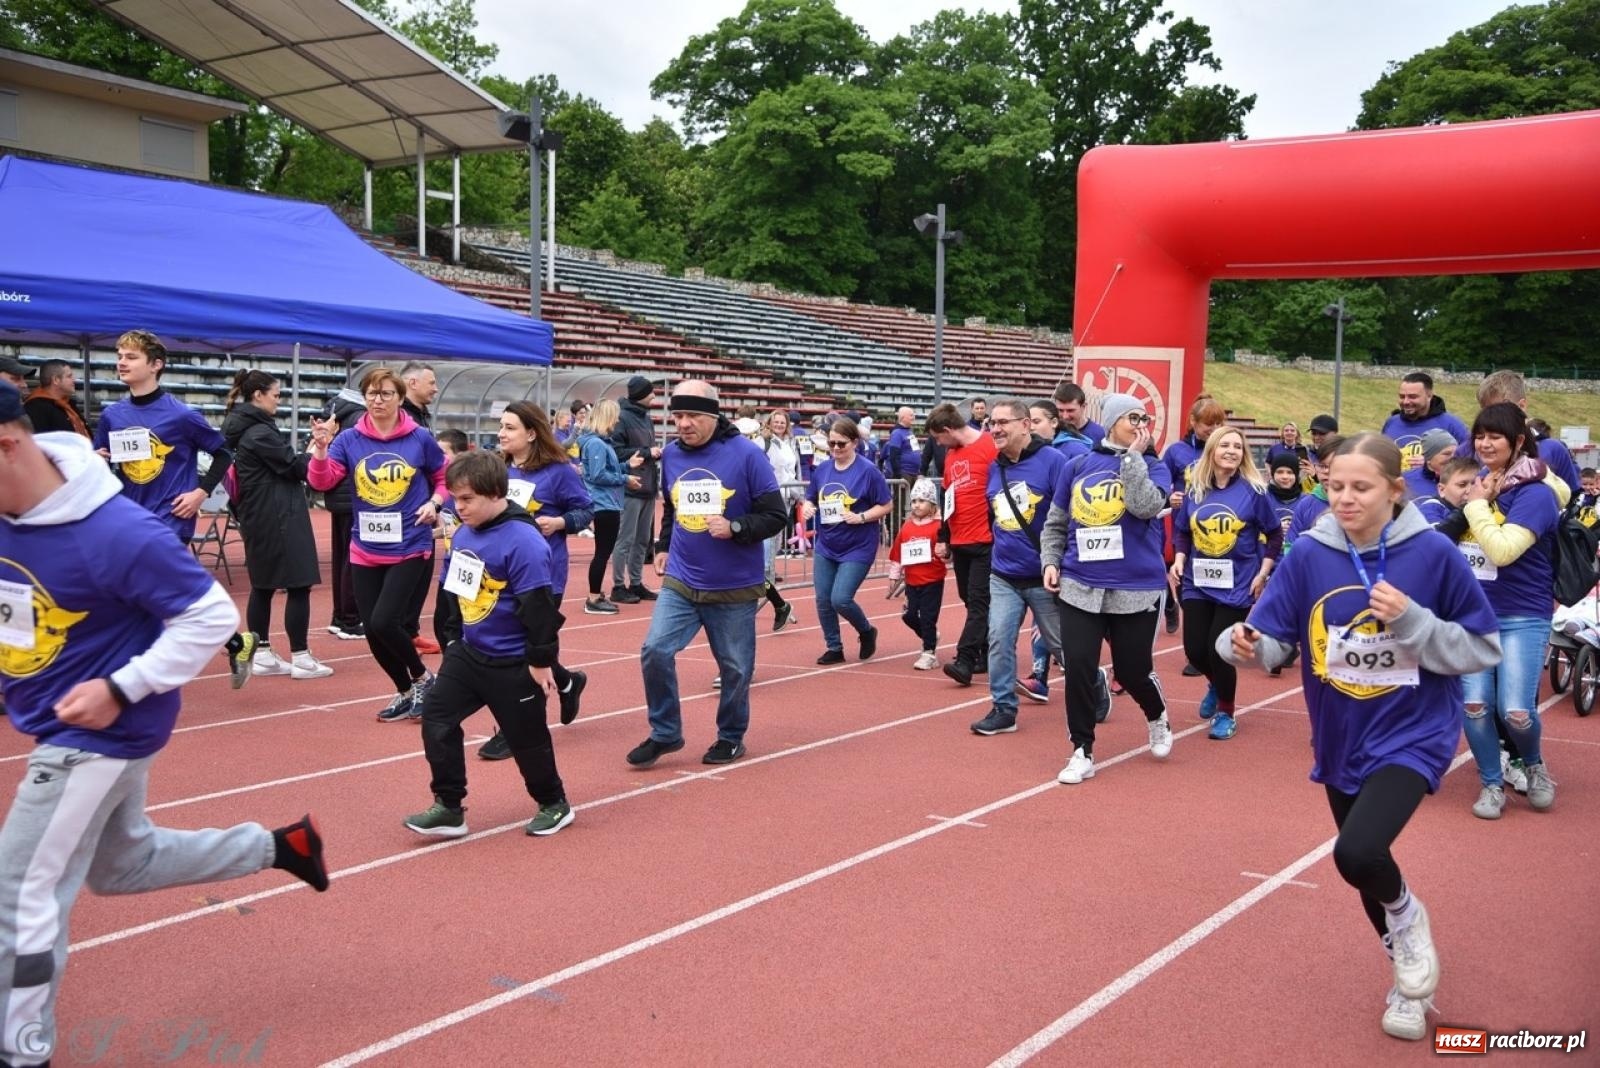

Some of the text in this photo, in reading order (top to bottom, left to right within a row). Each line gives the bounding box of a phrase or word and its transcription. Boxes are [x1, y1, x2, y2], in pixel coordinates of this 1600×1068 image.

[121, 440, 140, 451] 115
[687, 492, 711, 504] 033
[368, 522, 393, 533] 054
[1086, 538, 1111, 550] 077
[1463, 553, 1486, 569] 89
[458, 567, 474, 586] 158
[1204, 568, 1223, 579] 129
[1344, 649, 1396, 670] 093
